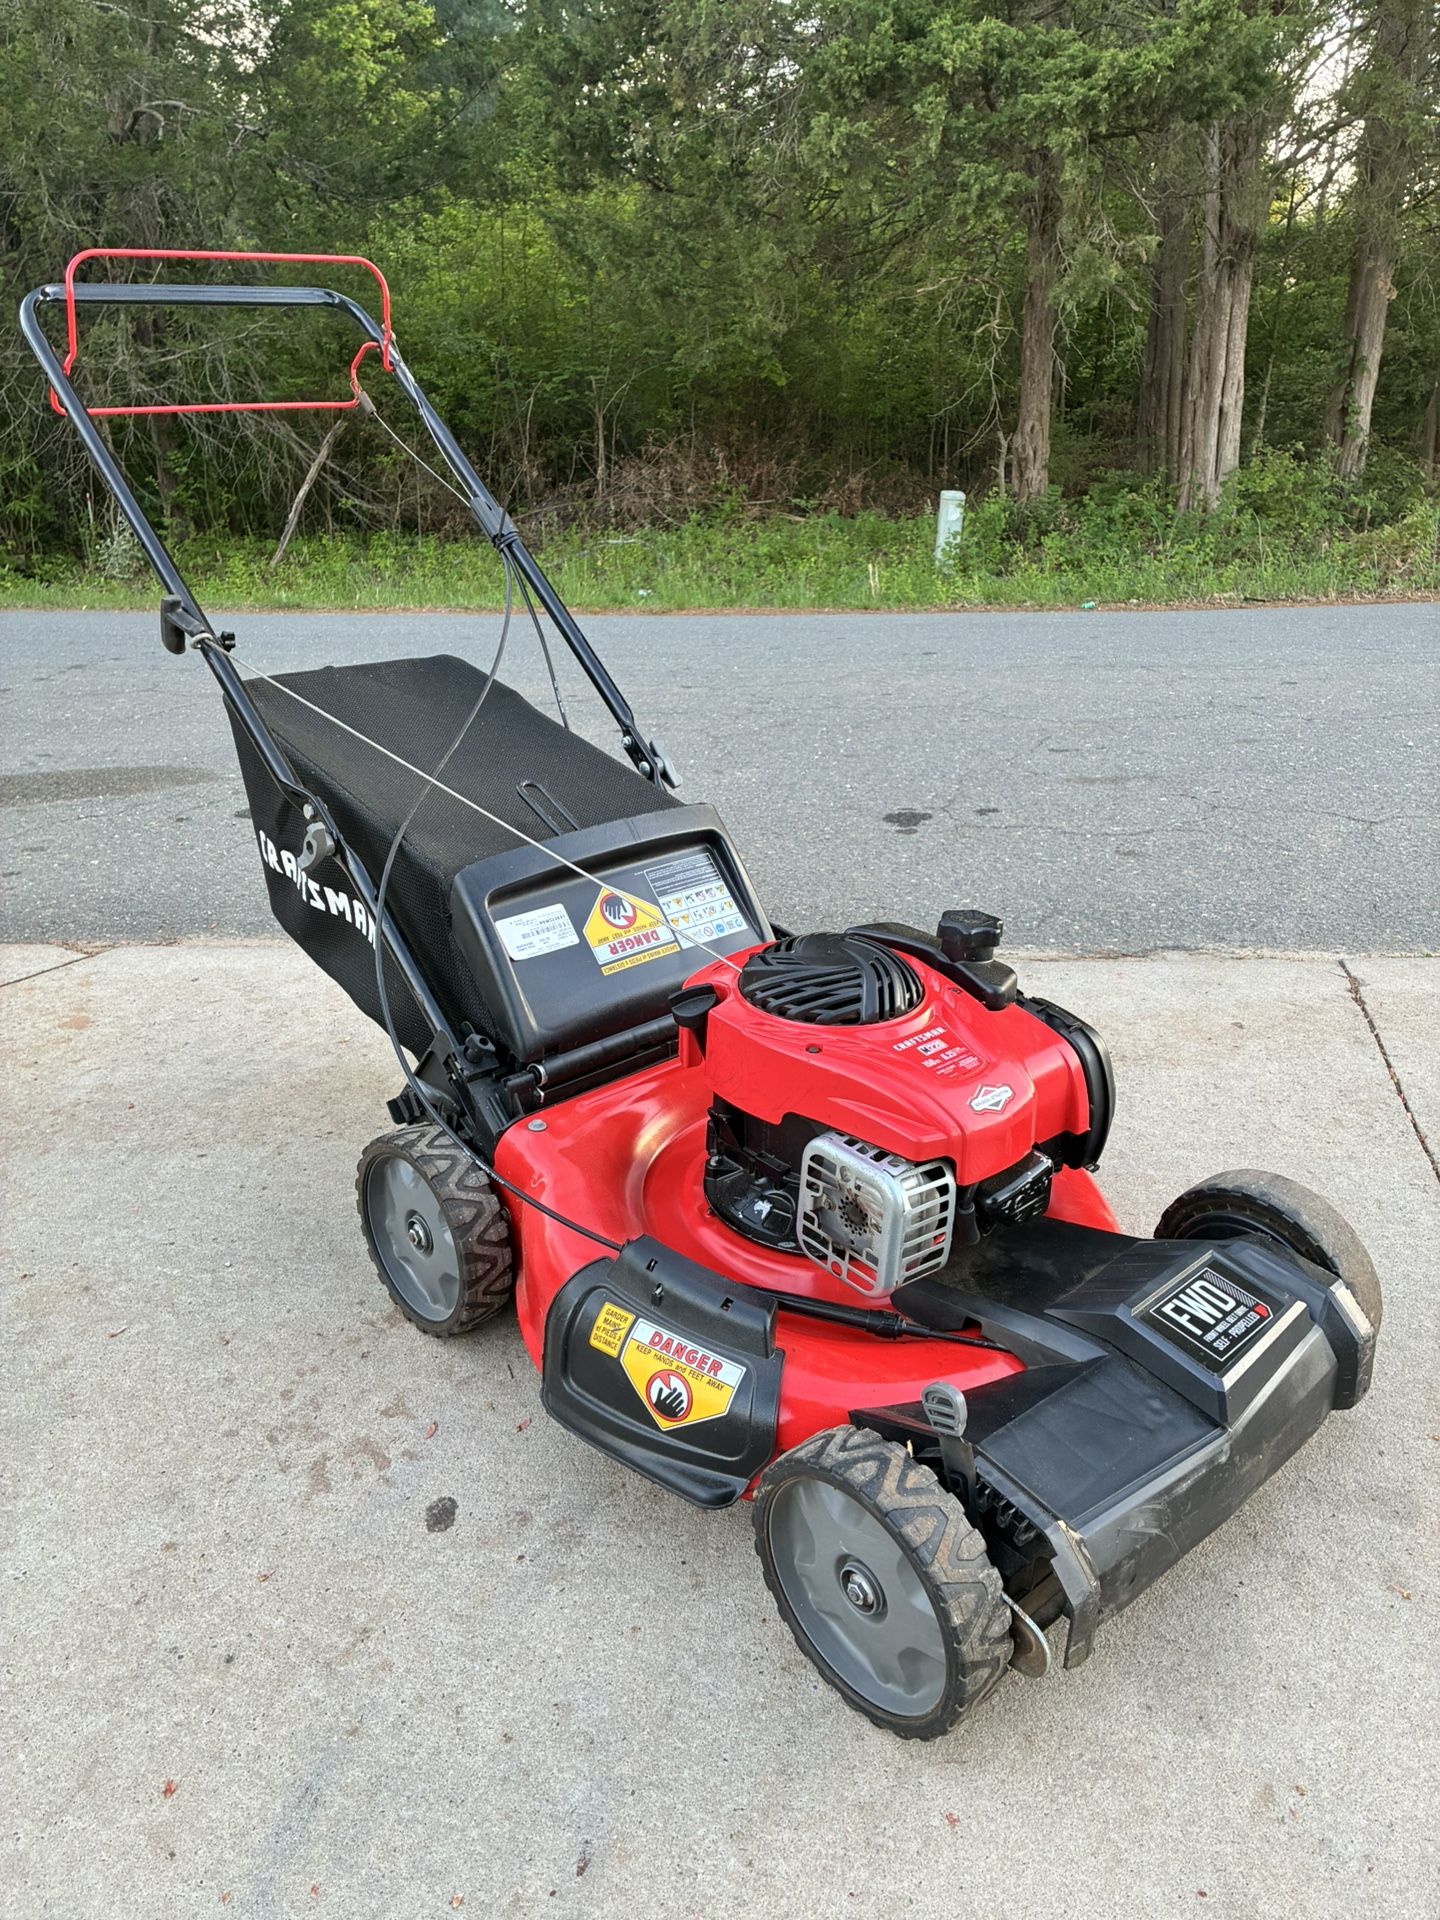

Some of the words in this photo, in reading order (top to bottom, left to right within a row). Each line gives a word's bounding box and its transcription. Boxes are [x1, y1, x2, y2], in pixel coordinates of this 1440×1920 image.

[608, 930, 660, 955] DANGER
[892, 1027, 946, 1051] CRAFTSMAN
[605, 1308, 629, 1324] GARDER
[1161, 1279, 1237, 1336] FWD
[593, 1332, 618, 1350] DISTANCE
[600, 1326, 618, 1340] PIEDS
[648, 1330, 724, 1377] DANGER
[636, 1344, 652, 1356] KEEP
[654, 1353, 674, 1367] HANDS
[675, 1364, 687, 1374] and
[689, 1370, 705, 1382] FEET
[706, 1379, 725, 1392] AWAY
